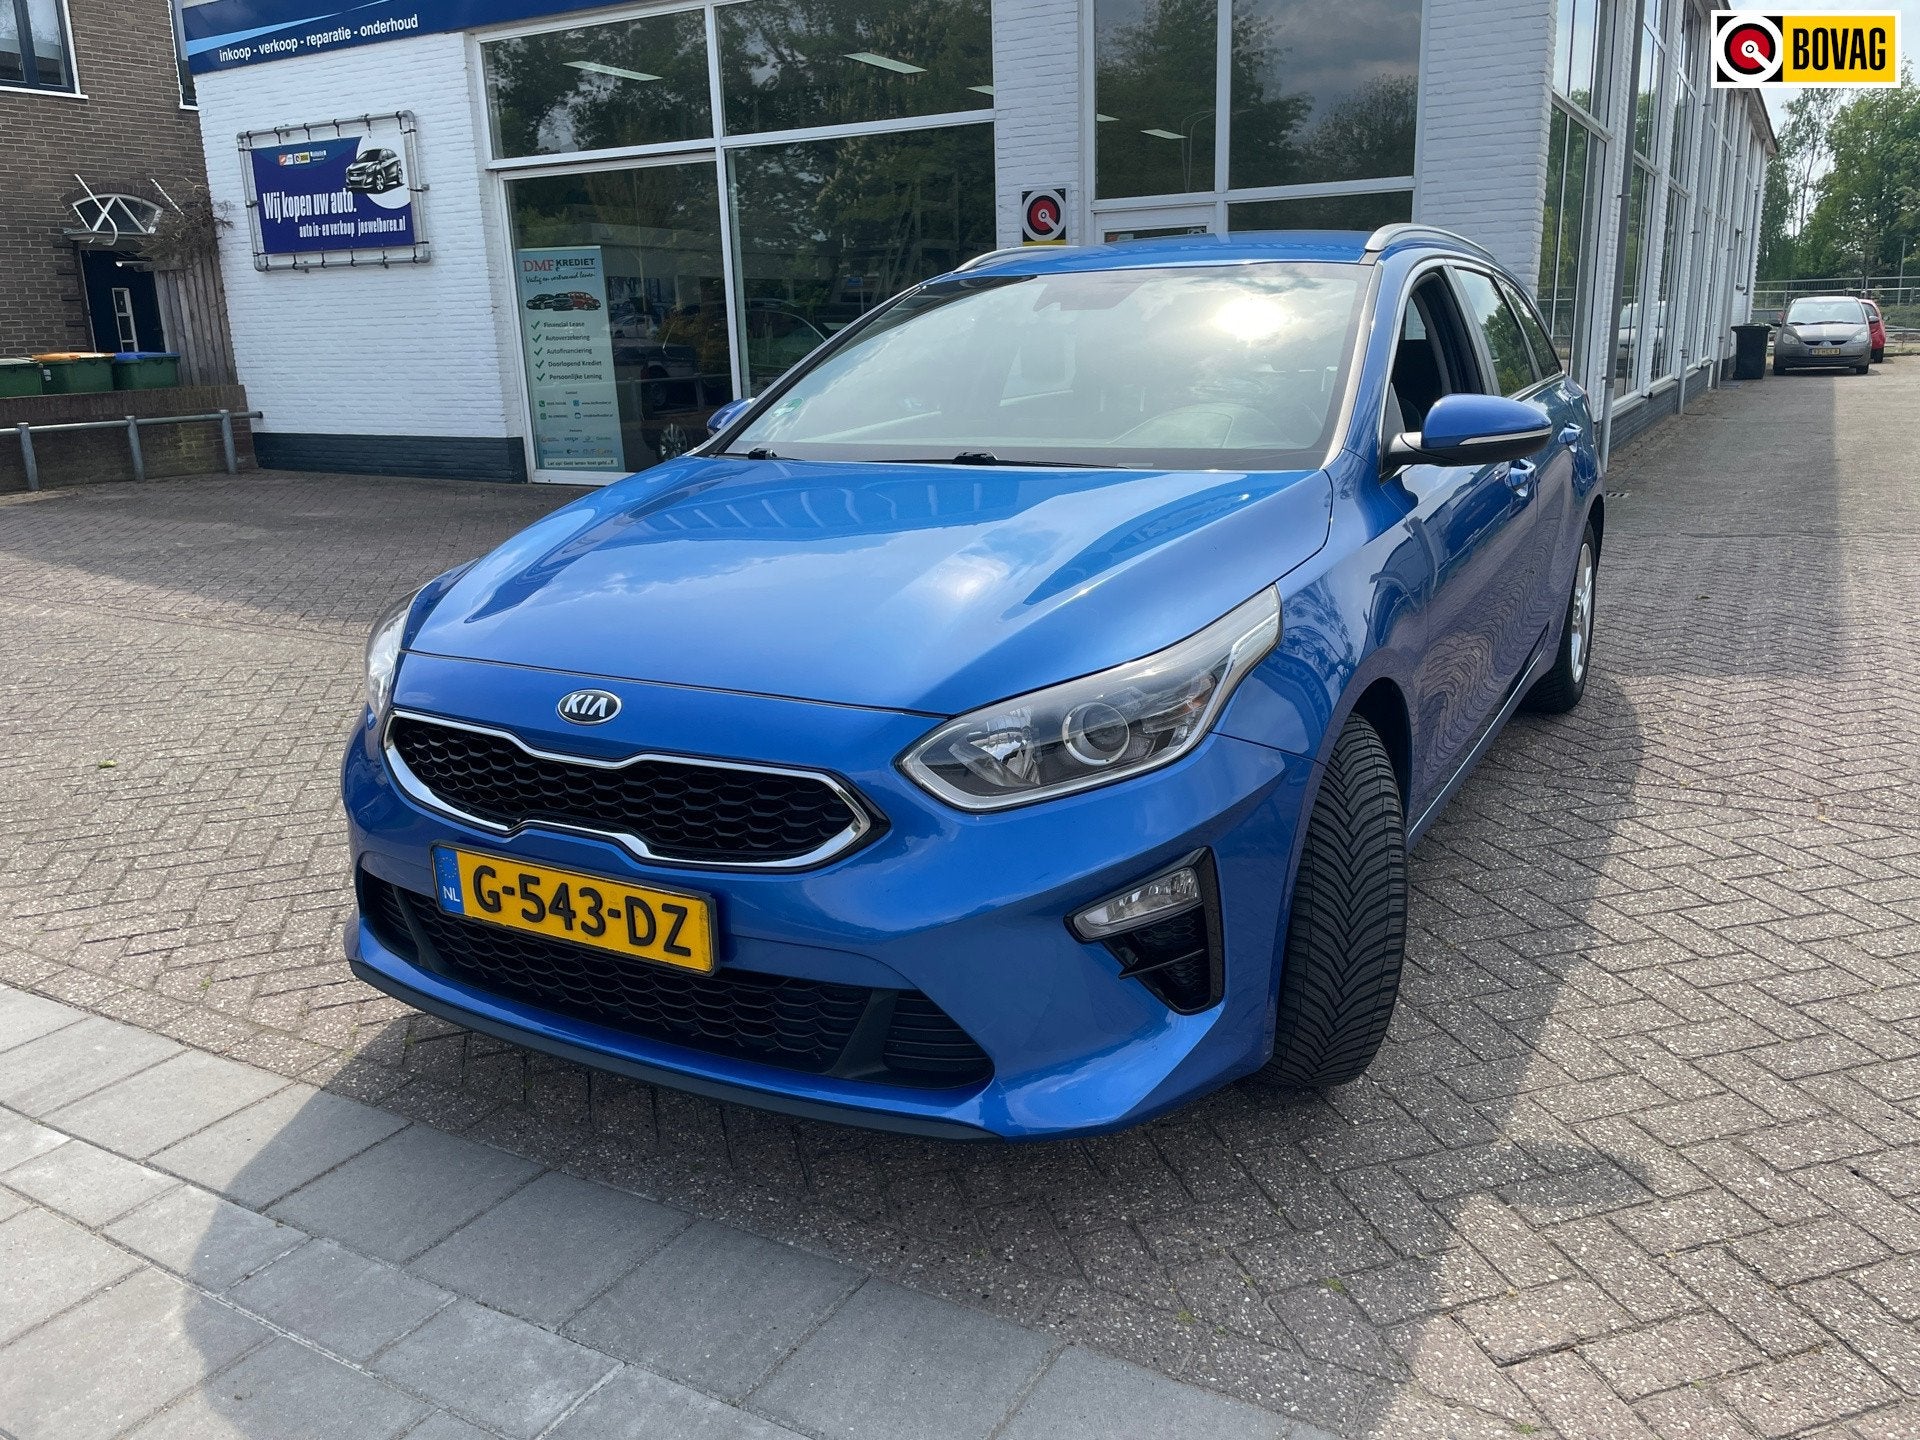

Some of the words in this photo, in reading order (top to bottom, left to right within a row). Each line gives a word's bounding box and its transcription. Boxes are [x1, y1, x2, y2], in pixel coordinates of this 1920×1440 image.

[219, 46, 251, 62] inkoop
[259, 37, 298, 55] verkoop
[306, 27, 351, 48] reparatie
[360, 14, 418, 37] onderhoud
[263, 191, 281, 224] Wij
[282, 191, 312, 223] kopen
[313, 192, 329, 216] uw
[330, 187, 357, 214] auto.
[330, 220, 355, 238] verkoop
[522, 259, 554, 272] DMF
[555, 258, 595, 267] KREDIET
[545, 334, 590, 342] Autoverzekering
[546, 347, 592, 355] Autofinanciering
[548, 360, 580, 368] Doorlopend
[549, 373, 582, 381] Persoonlijke
[584, 373, 602, 381] Lening
[564, 694, 608, 718] KIA
[442, 885, 461, 903] NL
[472, 864, 691, 957] G-543-DZ
